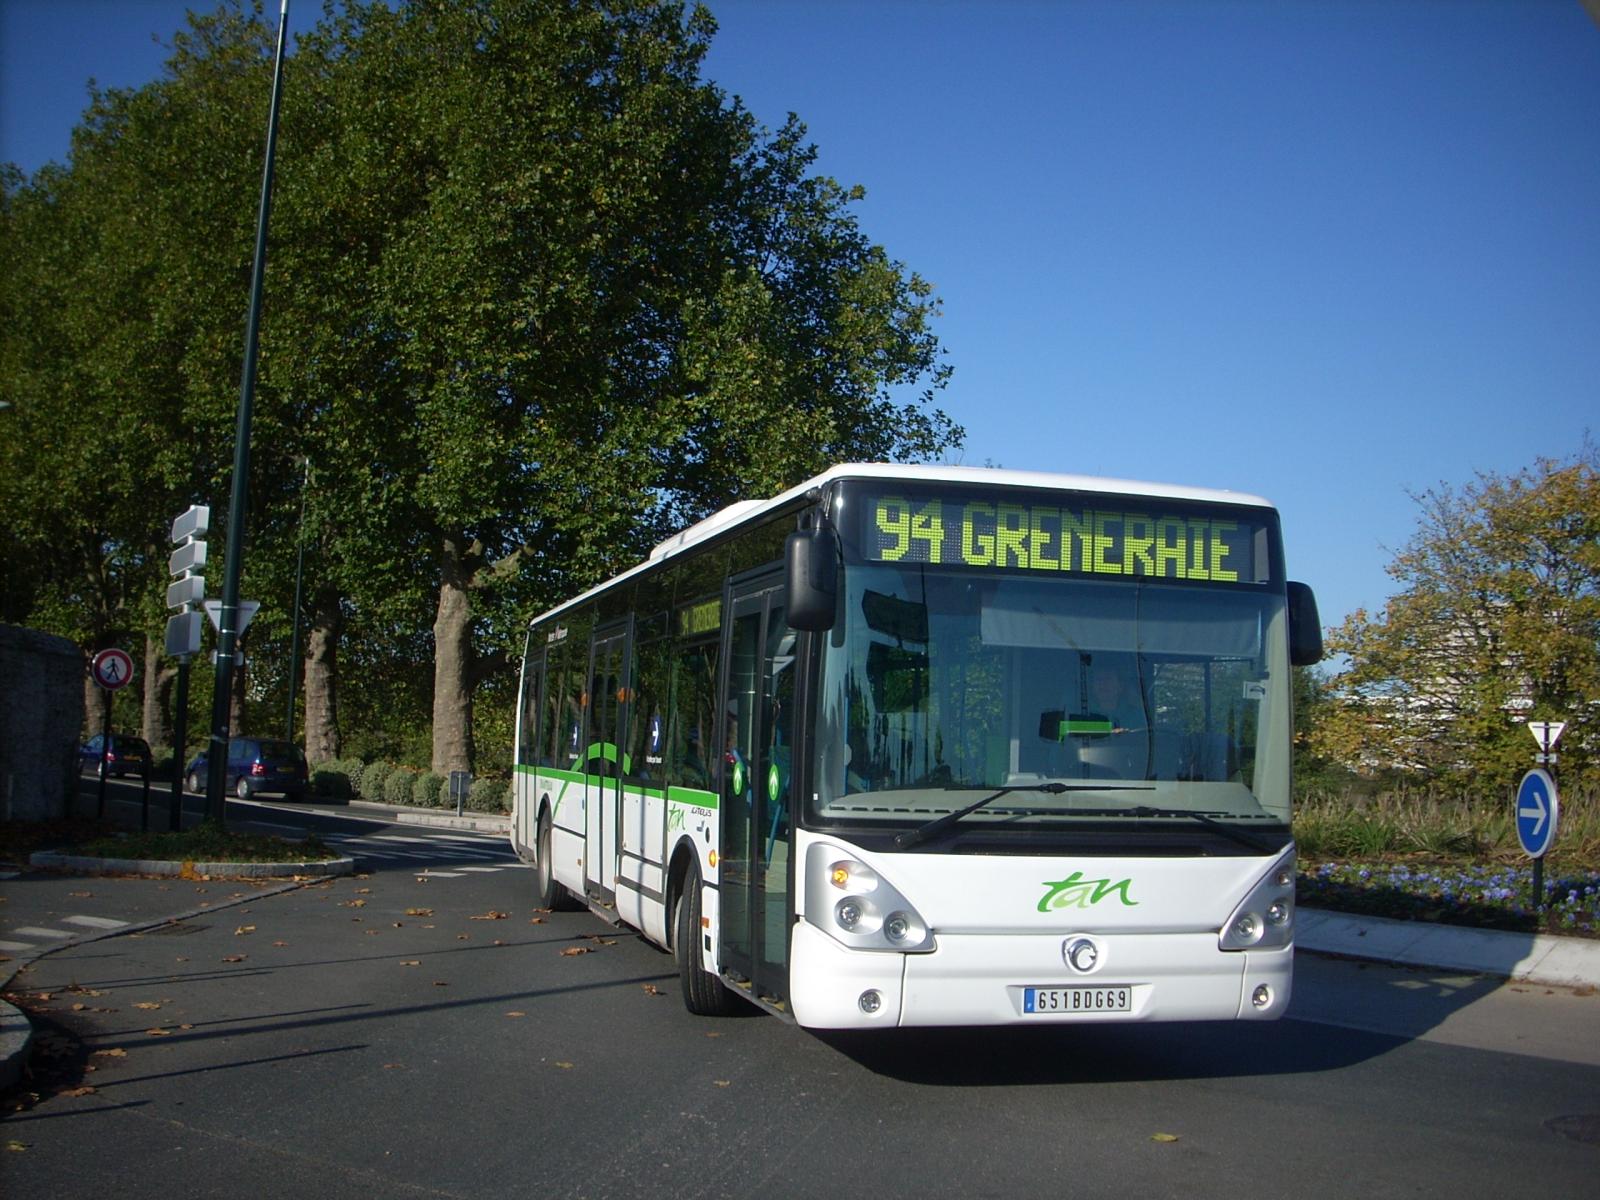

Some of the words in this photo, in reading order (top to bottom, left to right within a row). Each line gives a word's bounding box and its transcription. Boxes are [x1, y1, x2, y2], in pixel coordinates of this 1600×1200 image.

[876, 496, 944, 563] 94
[962, 501, 1238, 582] GRENERAIE
[1037, 871, 1140, 913] tan
[1038, 991, 1126, 1010] 651BDG69
